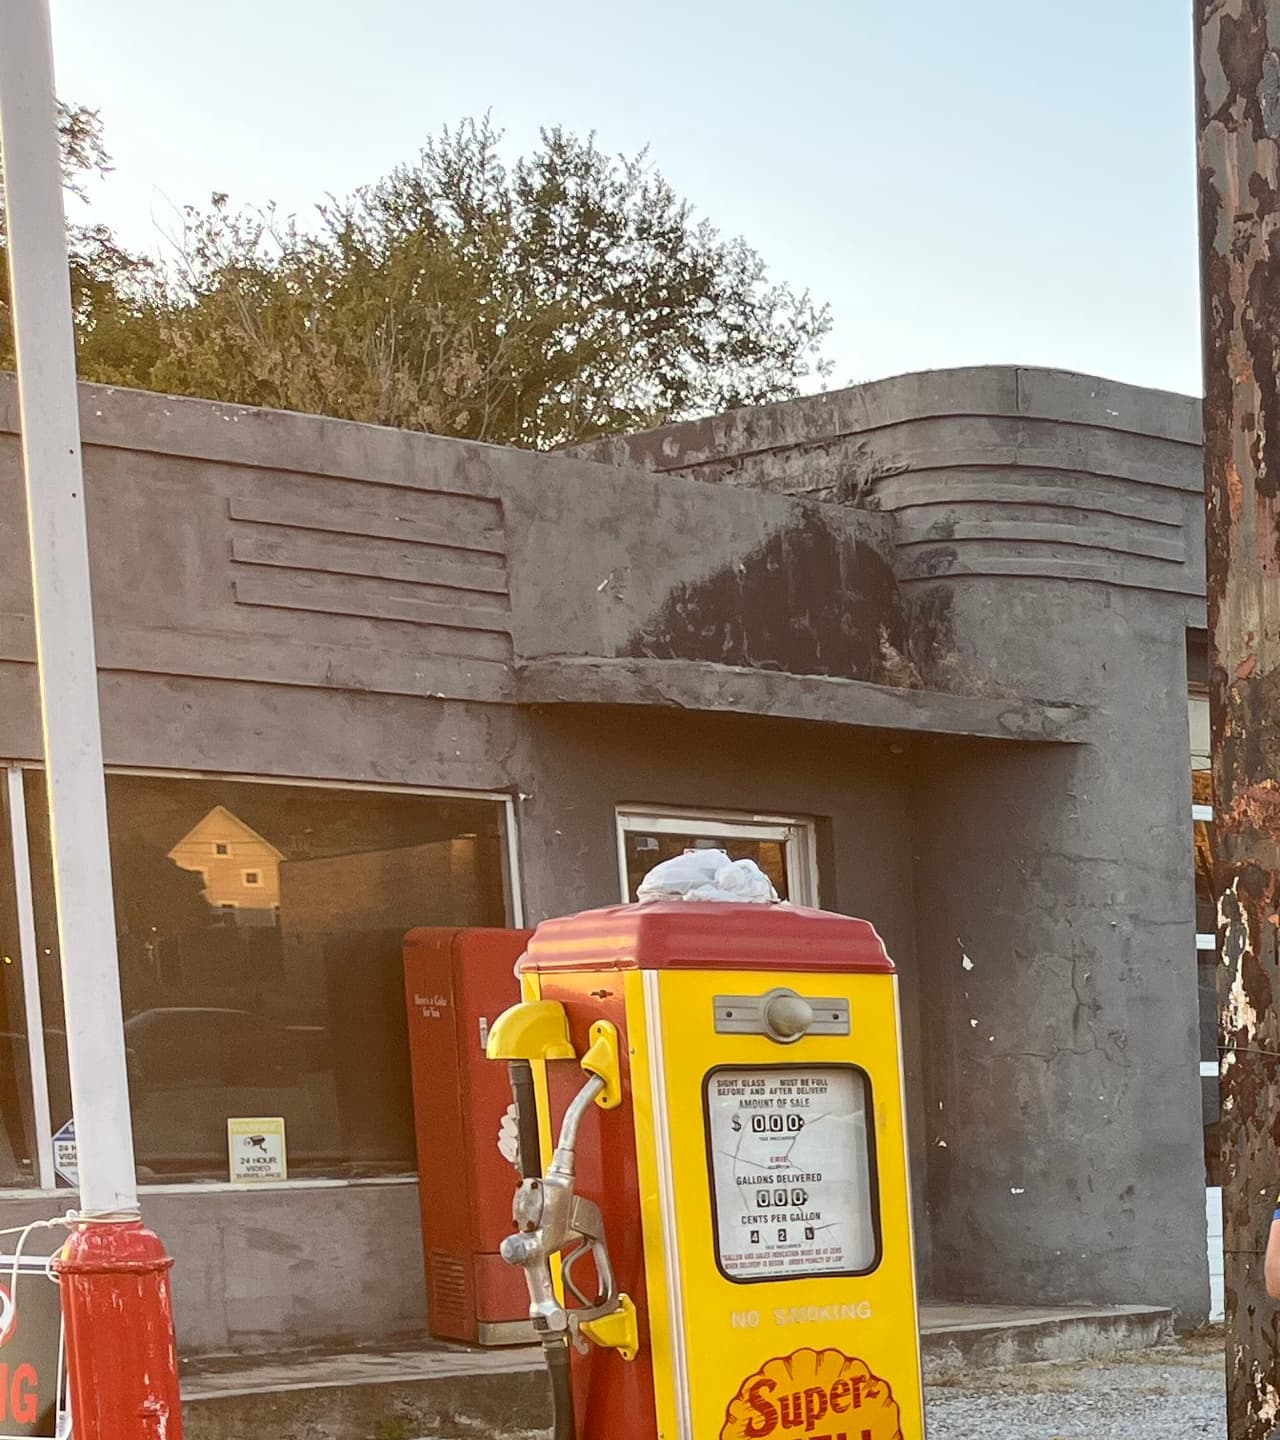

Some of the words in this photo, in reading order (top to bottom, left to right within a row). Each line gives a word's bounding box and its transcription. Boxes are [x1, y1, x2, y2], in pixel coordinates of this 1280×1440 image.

[716, 1080, 738, 1088] SIGHT
[717, 1088, 745, 1096] BEFORE
[796, 1087, 828, 1095] DELIVERY
[739, 1099, 774, 1109] AMOUNT
[776, 1099, 787, 1108] OF
[790, 1098, 810, 1107] SALE
[731, 1113, 742, 1132] $
[736, 1175, 774, 1185] GALLONS
[776, 1173, 822, 1183] DELIVERED
[741, 1215, 769, 1225] CENTS
[771, 1214, 787, 1223] PER
[790, 1212, 821, 1221] GALLON
[751, 1231, 759, 1243] 4
[778, 1229, 787, 1241] 2
[731, 1311, 760, 1328] NO
[774, 1301, 873, 1326] SMOKING
